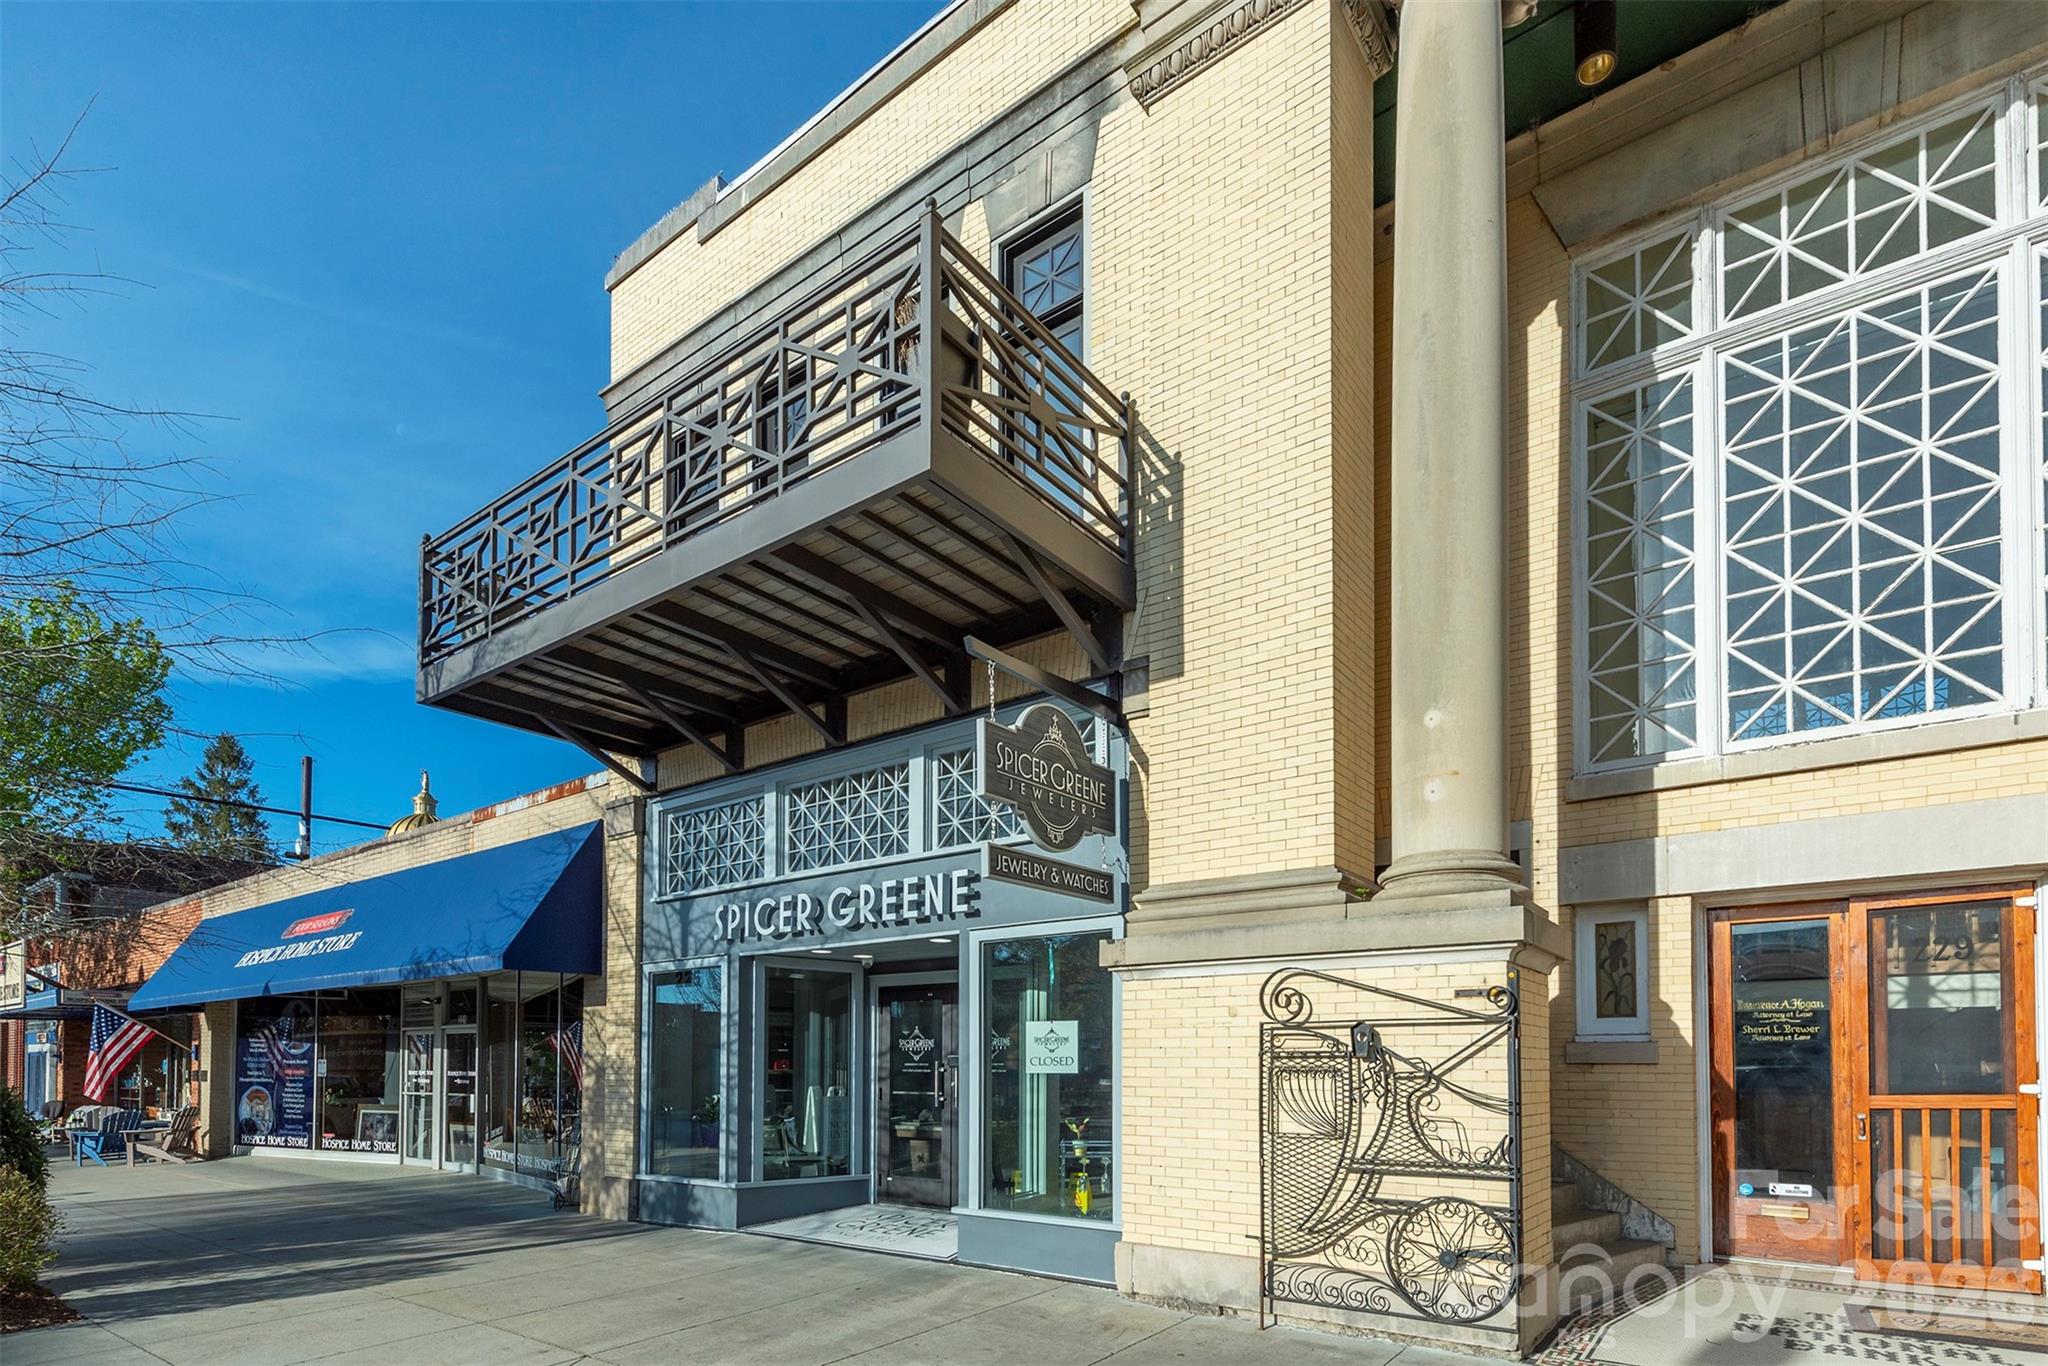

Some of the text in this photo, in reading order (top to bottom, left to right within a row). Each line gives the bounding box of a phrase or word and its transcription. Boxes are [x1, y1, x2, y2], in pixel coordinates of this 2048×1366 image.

[995, 741, 1107, 806] SPICER GREENE
[1008, 778, 1097, 818] JEWELERS
[996, 853, 1109, 895] JEWELRY & WATCHES
[713, 868, 973, 941] SPICER GREENE
[234, 931, 363, 968] HOSPICE HOME STORE
[1912, 934, 1974, 962] 229
[1791, 998, 1825, 1011] Hogan
[1742, 1024, 1771, 1034] Sherri
[1782, 1024, 1820, 1034] Brewer
[1030, 1056, 1074, 1067] CLOSED
[241, 1133, 309, 1147] HOSPICE HOME STORE
[322, 1137, 397, 1152] HOSPICE HOME STORE
